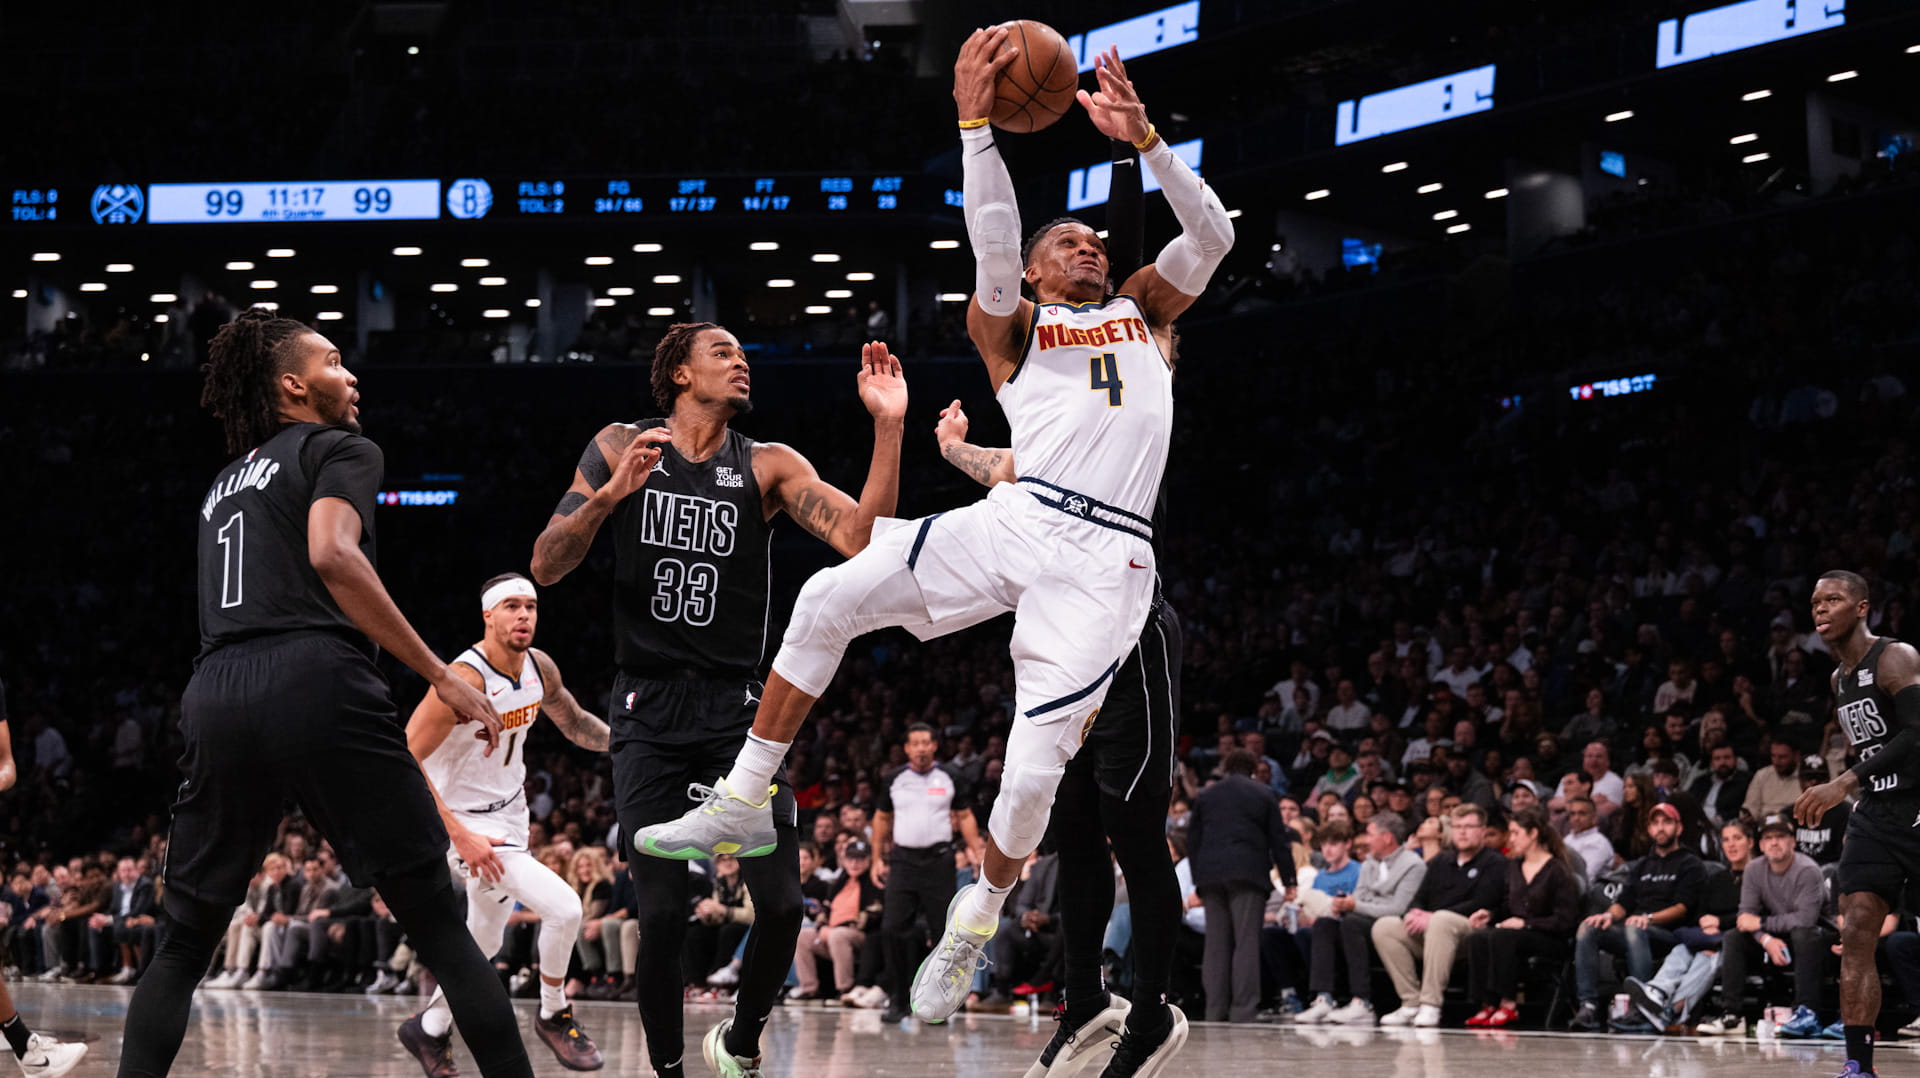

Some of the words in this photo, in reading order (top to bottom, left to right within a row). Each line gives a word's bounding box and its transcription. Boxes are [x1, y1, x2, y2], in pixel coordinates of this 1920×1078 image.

[205, 190, 244, 217] 99
[269, 188, 326, 206] 11:17
[354, 187, 392, 215] 99
[607, 180, 630, 195] FG
[678, 179, 707, 195] 3PT
[755, 178, 776, 193] FT
[820, 177, 853, 192] REB
[871, 177, 903, 192] AST
[1036, 317, 1149, 352] NUGGETS
[1089, 352, 1125, 408] 4
[716, 466, 733, 475] GET
[716, 473, 742, 482] YOUR
[716, 479, 744, 488] GUIDE
[202, 458, 281, 522] WILLIAMS
[399, 489, 459, 506] TISSOT
[640, 488, 739, 557] NETS
[217, 510, 244, 609] 1
[650, 557, 719, 627] 33
